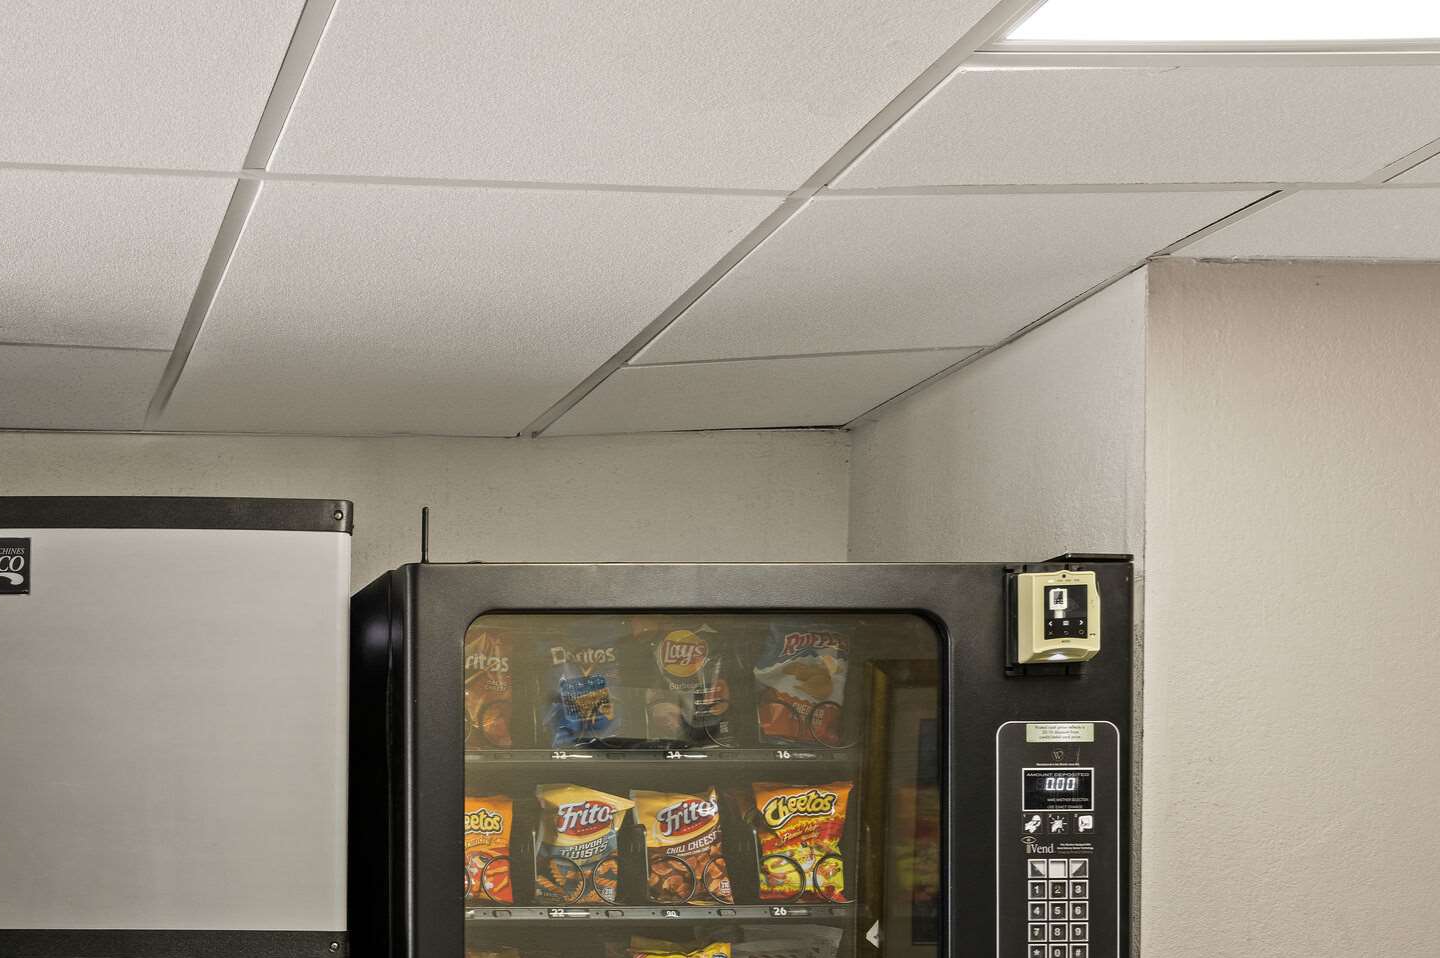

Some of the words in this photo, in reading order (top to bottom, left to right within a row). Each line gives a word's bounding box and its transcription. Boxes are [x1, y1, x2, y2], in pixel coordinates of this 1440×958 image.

[550, 646, 616, 665] Doritos
[465, 655, 509, 673] ritos
[776, 750, 791, 759] 16
[1046, 777, 1076, 791] 0.00
[763, 790, 837, 828] Cheetos
[464, 809, 502, 833] eetos
[569, 837, 603, 851] FLAVOR
[1026, 838, 1055, 854] iVend
[560, 842, 608, 860] TWISTS
[666, 844, 687, 855] CHILI
[1034, 885, 1040, 894] 1
[1054, 885, 1061, 894] 2
[1075, 885, 1082, 894] 3
[773, 907, 787, 916] 26
[1033, 906, 1040, 915] 4
[1054, 906, 1061, 915] 5
[1074, 906, 1081, 915] 6
[1033, 927, 1040, 936] 7
[1054, 927, 1061, 936] 8
[1074, 927, 1081, 936] 9
[1054, 948, 1061, 957] 0
